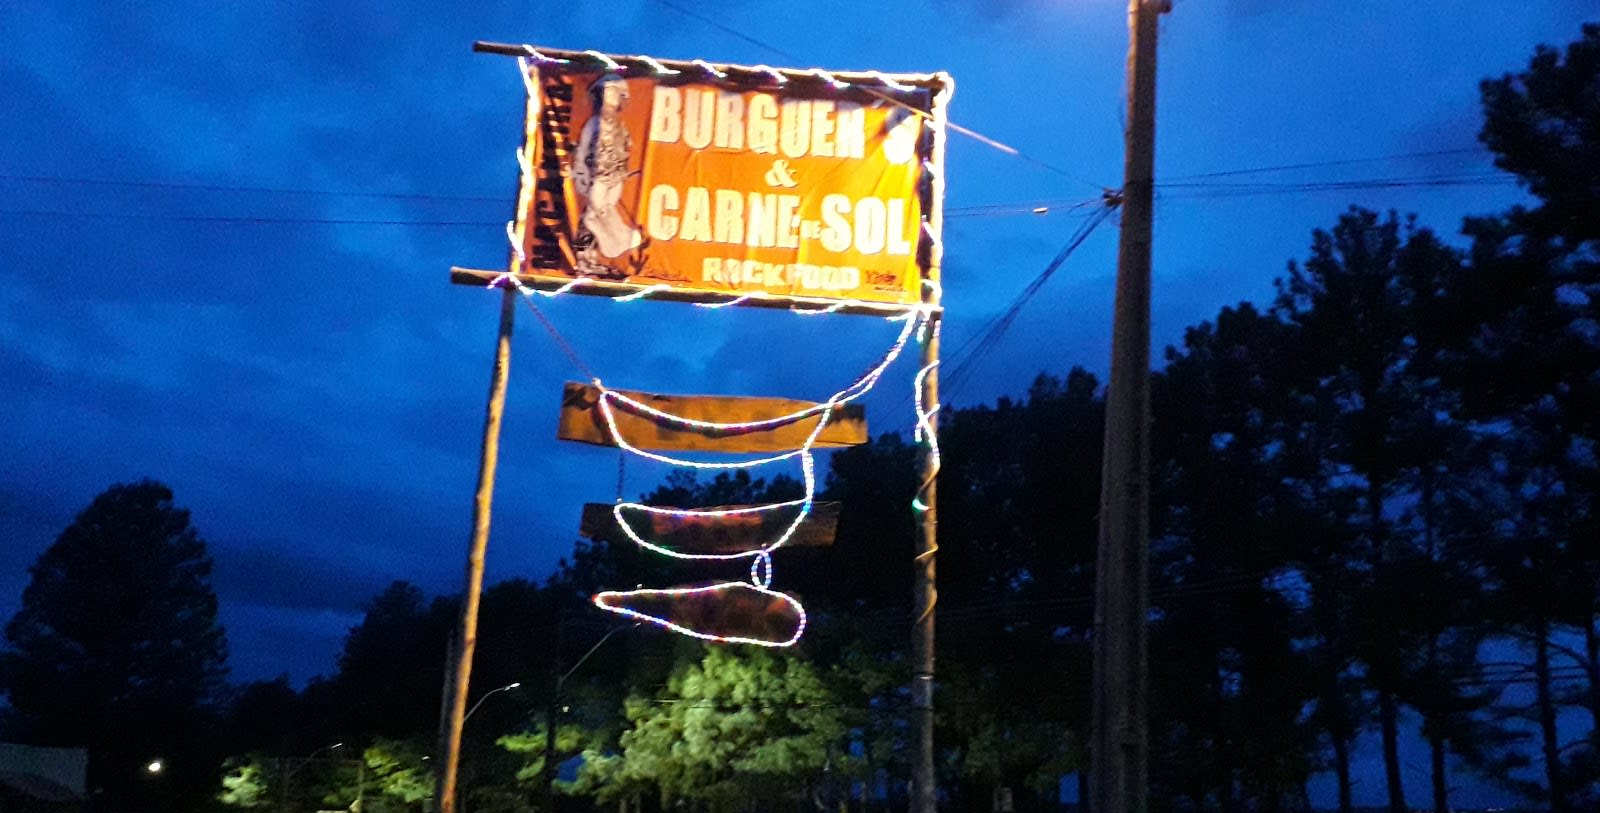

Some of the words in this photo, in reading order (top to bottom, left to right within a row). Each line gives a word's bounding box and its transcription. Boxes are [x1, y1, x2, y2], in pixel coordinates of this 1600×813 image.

[764, 159, 799, 188] &
[648, 184, 800, 249] CARNE
[820, 194, 910, 255] SOL
